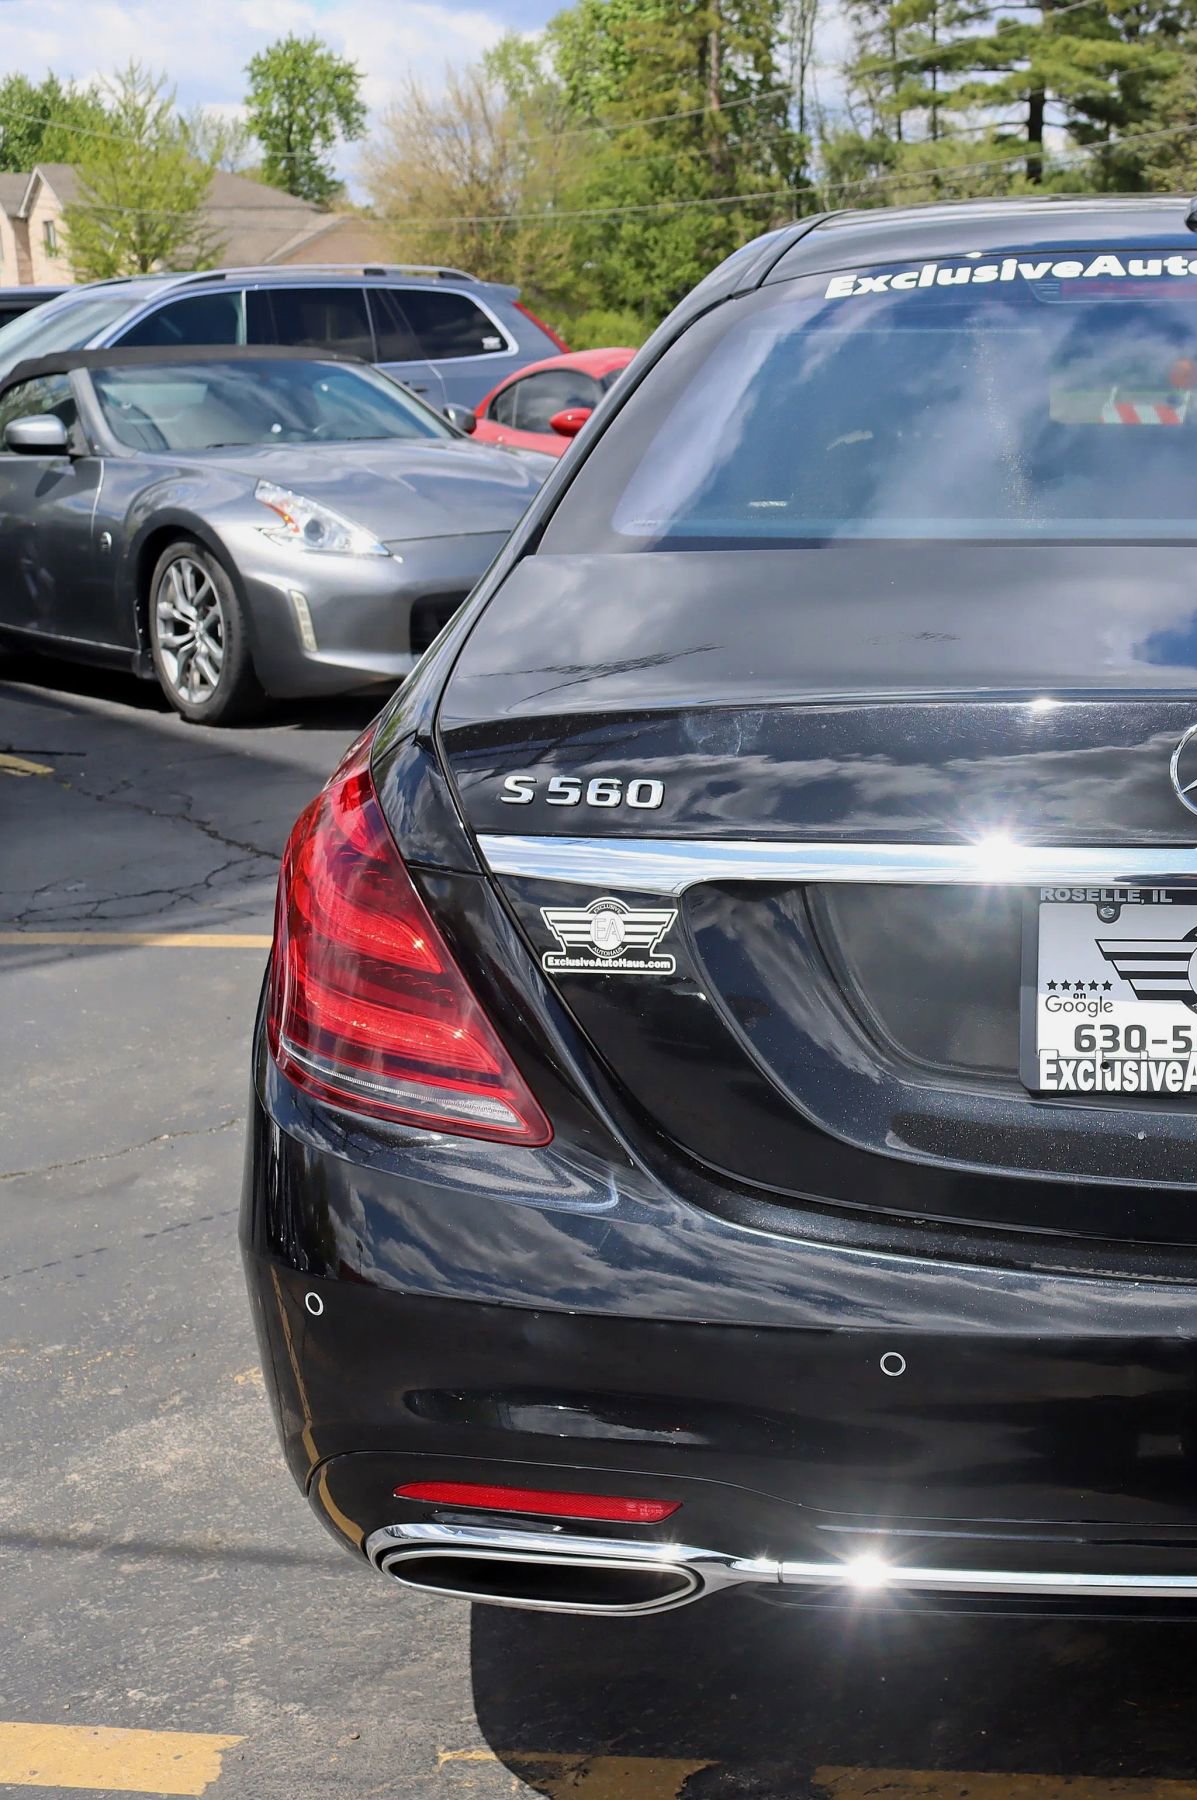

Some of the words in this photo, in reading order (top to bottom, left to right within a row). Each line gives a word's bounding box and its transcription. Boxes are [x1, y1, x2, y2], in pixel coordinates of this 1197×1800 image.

[500, 775, 538, 805] S
[545, 776, 664, 809] 560
[1040, 888, 1145, 904] ROSELLE,
[1152, 889, 1173, 903] IL
[547, 956, 671, 969] ExclusiveAutoHaus.com
[1072, 992, 1087, 1000] on
[1045, 995, 1114, 1018] Google
